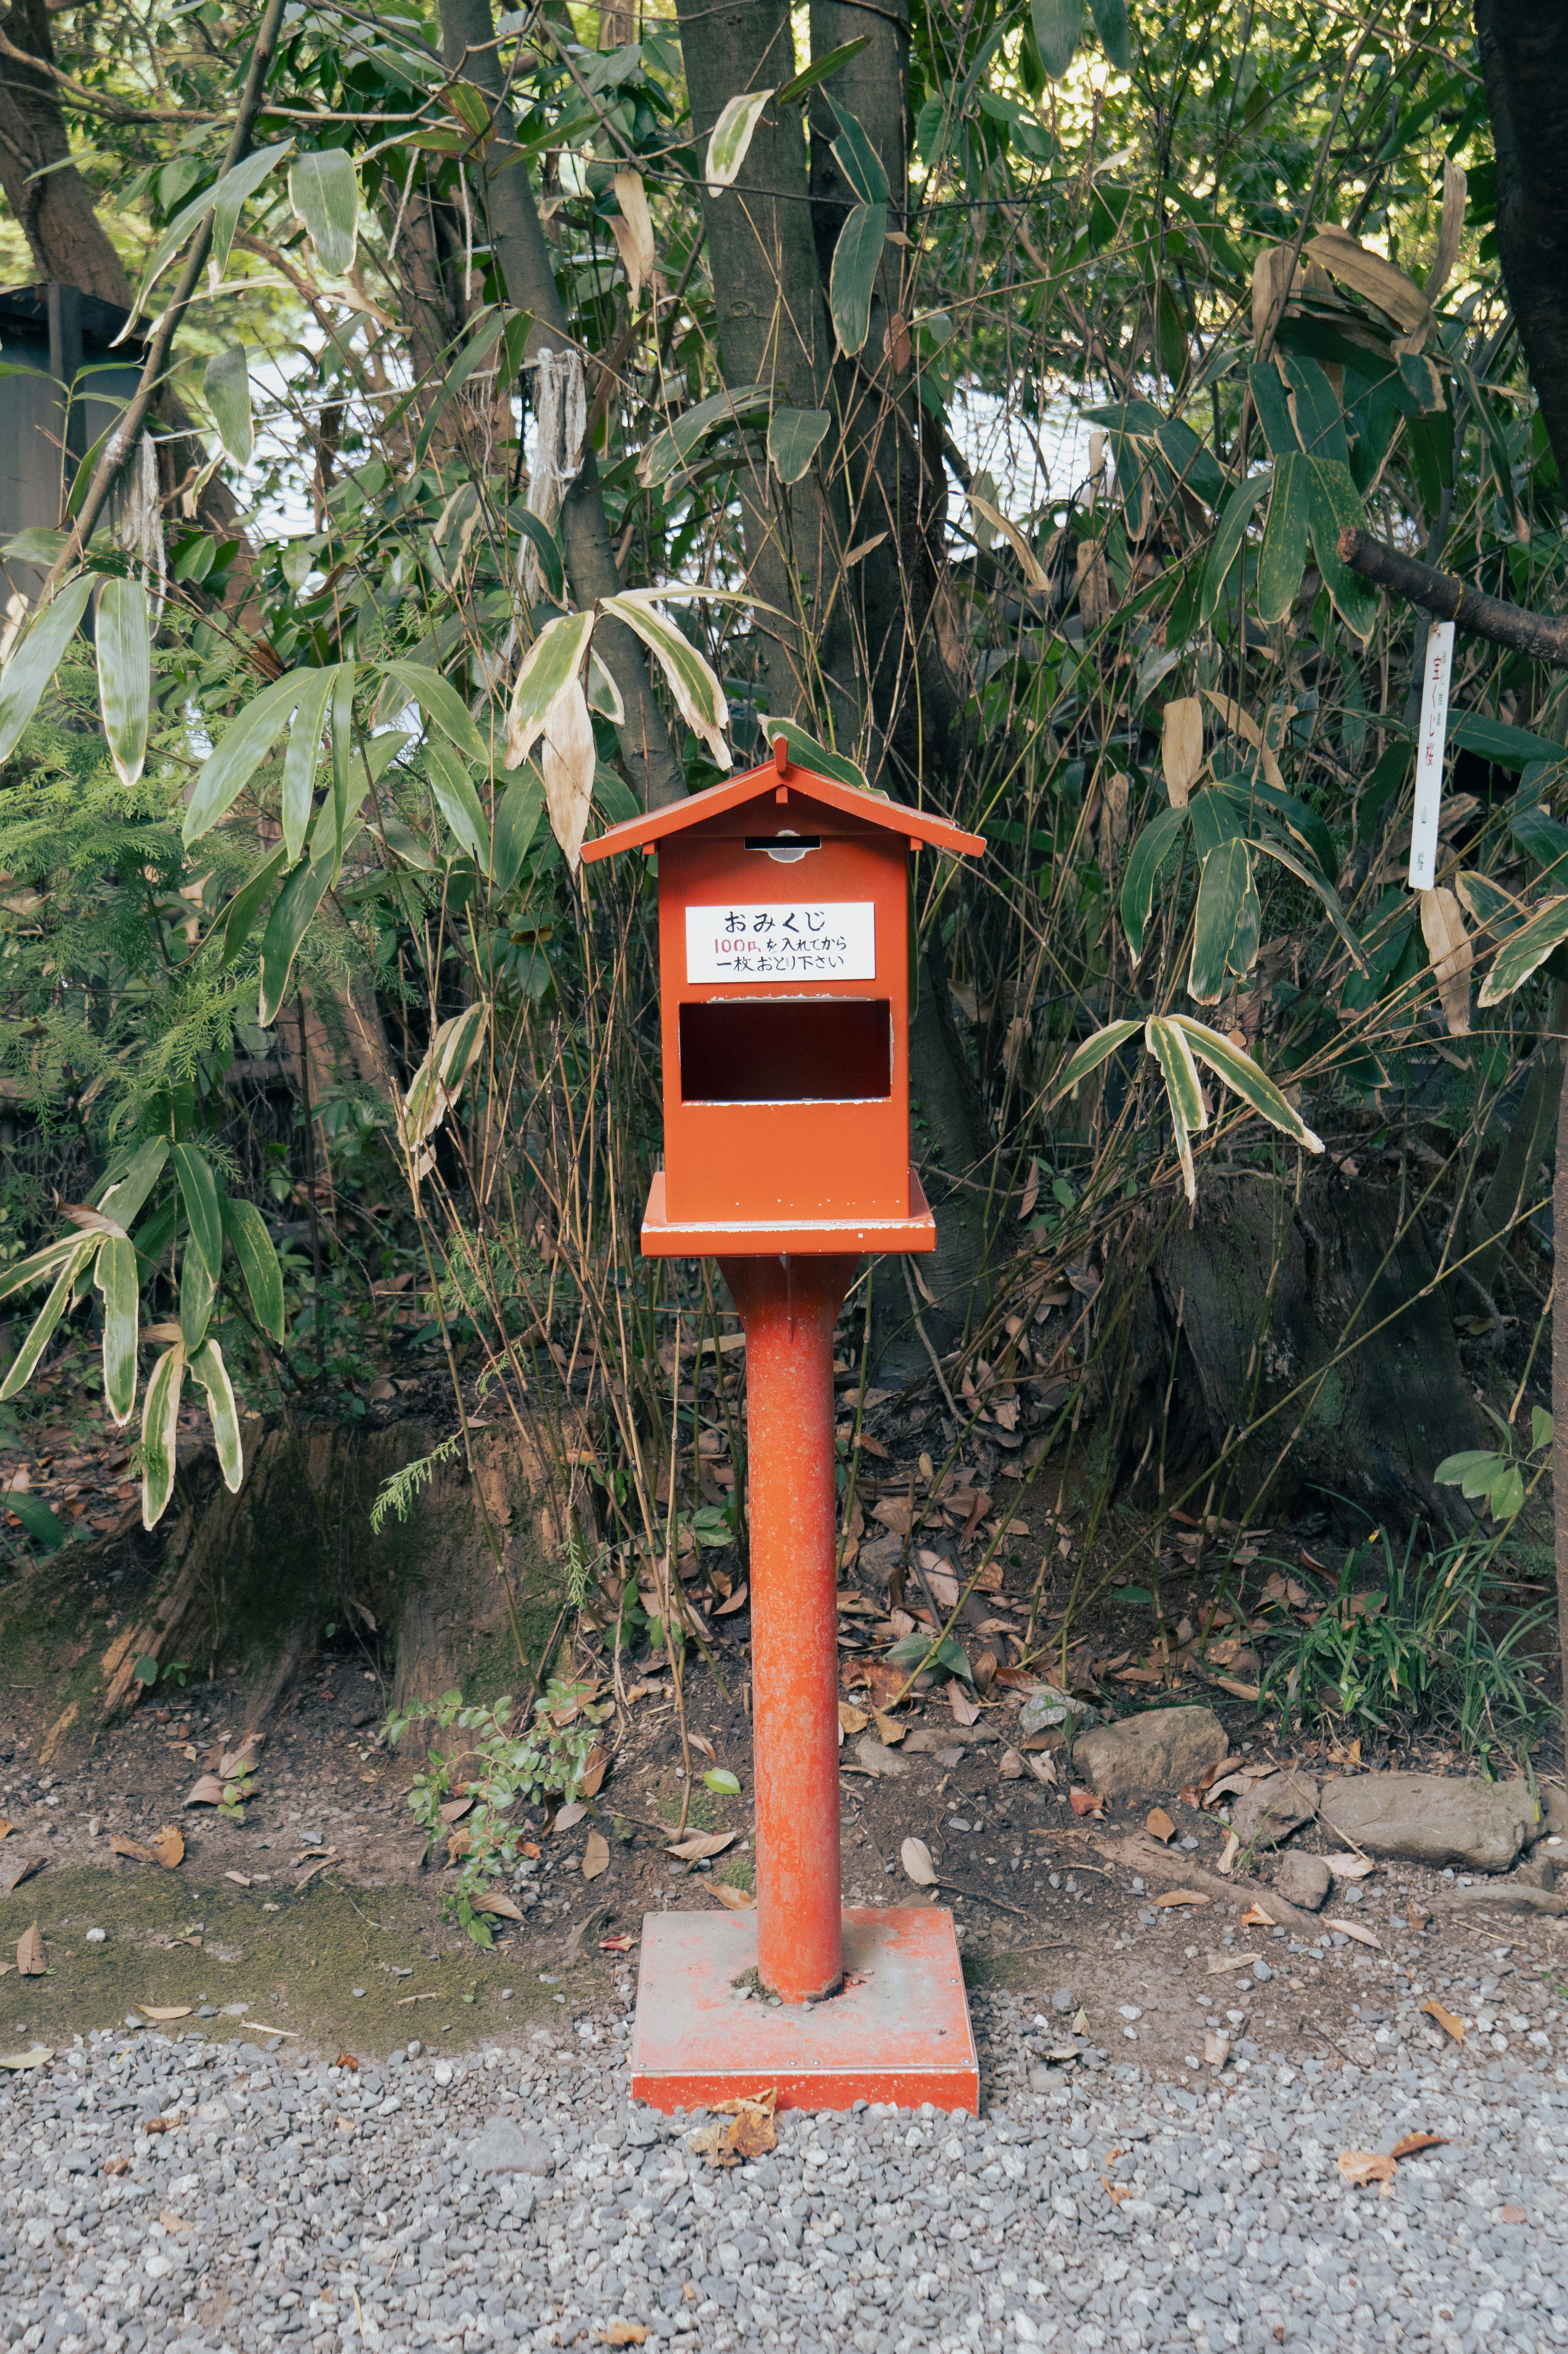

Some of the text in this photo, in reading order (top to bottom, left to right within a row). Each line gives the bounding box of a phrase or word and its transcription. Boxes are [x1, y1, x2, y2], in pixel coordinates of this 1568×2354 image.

[1425, 655, 1441, 767] 宝くじ桜
[725, 911, 825, 933] おみくじ
[714, 936, 847, 954] 100円を入れてから
[716, 955, 844, 972] 一枚おとり下さい
